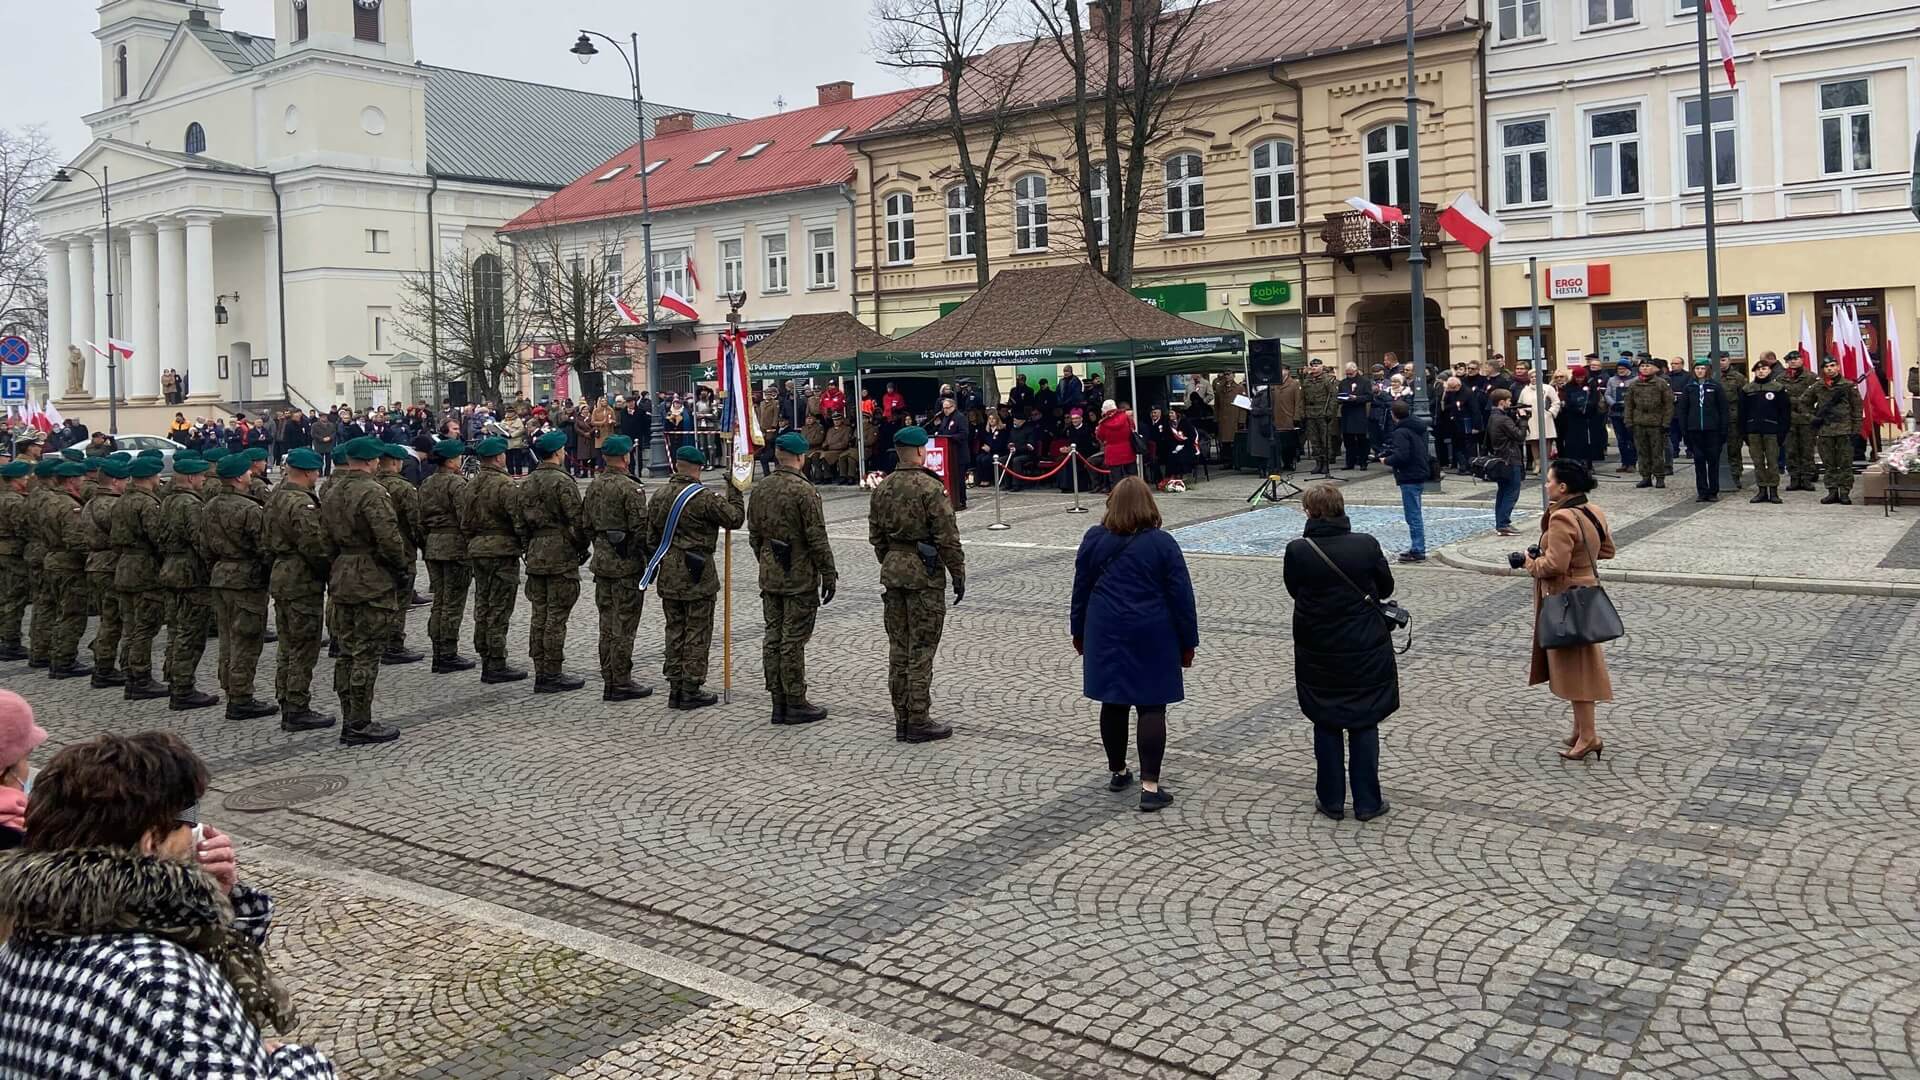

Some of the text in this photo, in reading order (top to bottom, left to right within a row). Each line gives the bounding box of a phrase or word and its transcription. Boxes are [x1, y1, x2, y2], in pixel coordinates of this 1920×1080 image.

[1555, 278, 1583, 287] ERGO
[1253, 286, 1286, 297] żabka
[1555, 286, 1583, 295] HESTIA
[1755, 299, 1777, 312] 55
[920, 351, 929, 359] 14
[930, 350, 963, 359] Suwalski
[983, 347, 1053, 358] Przeciwpancerny
[7, 378, 21, 396] P
